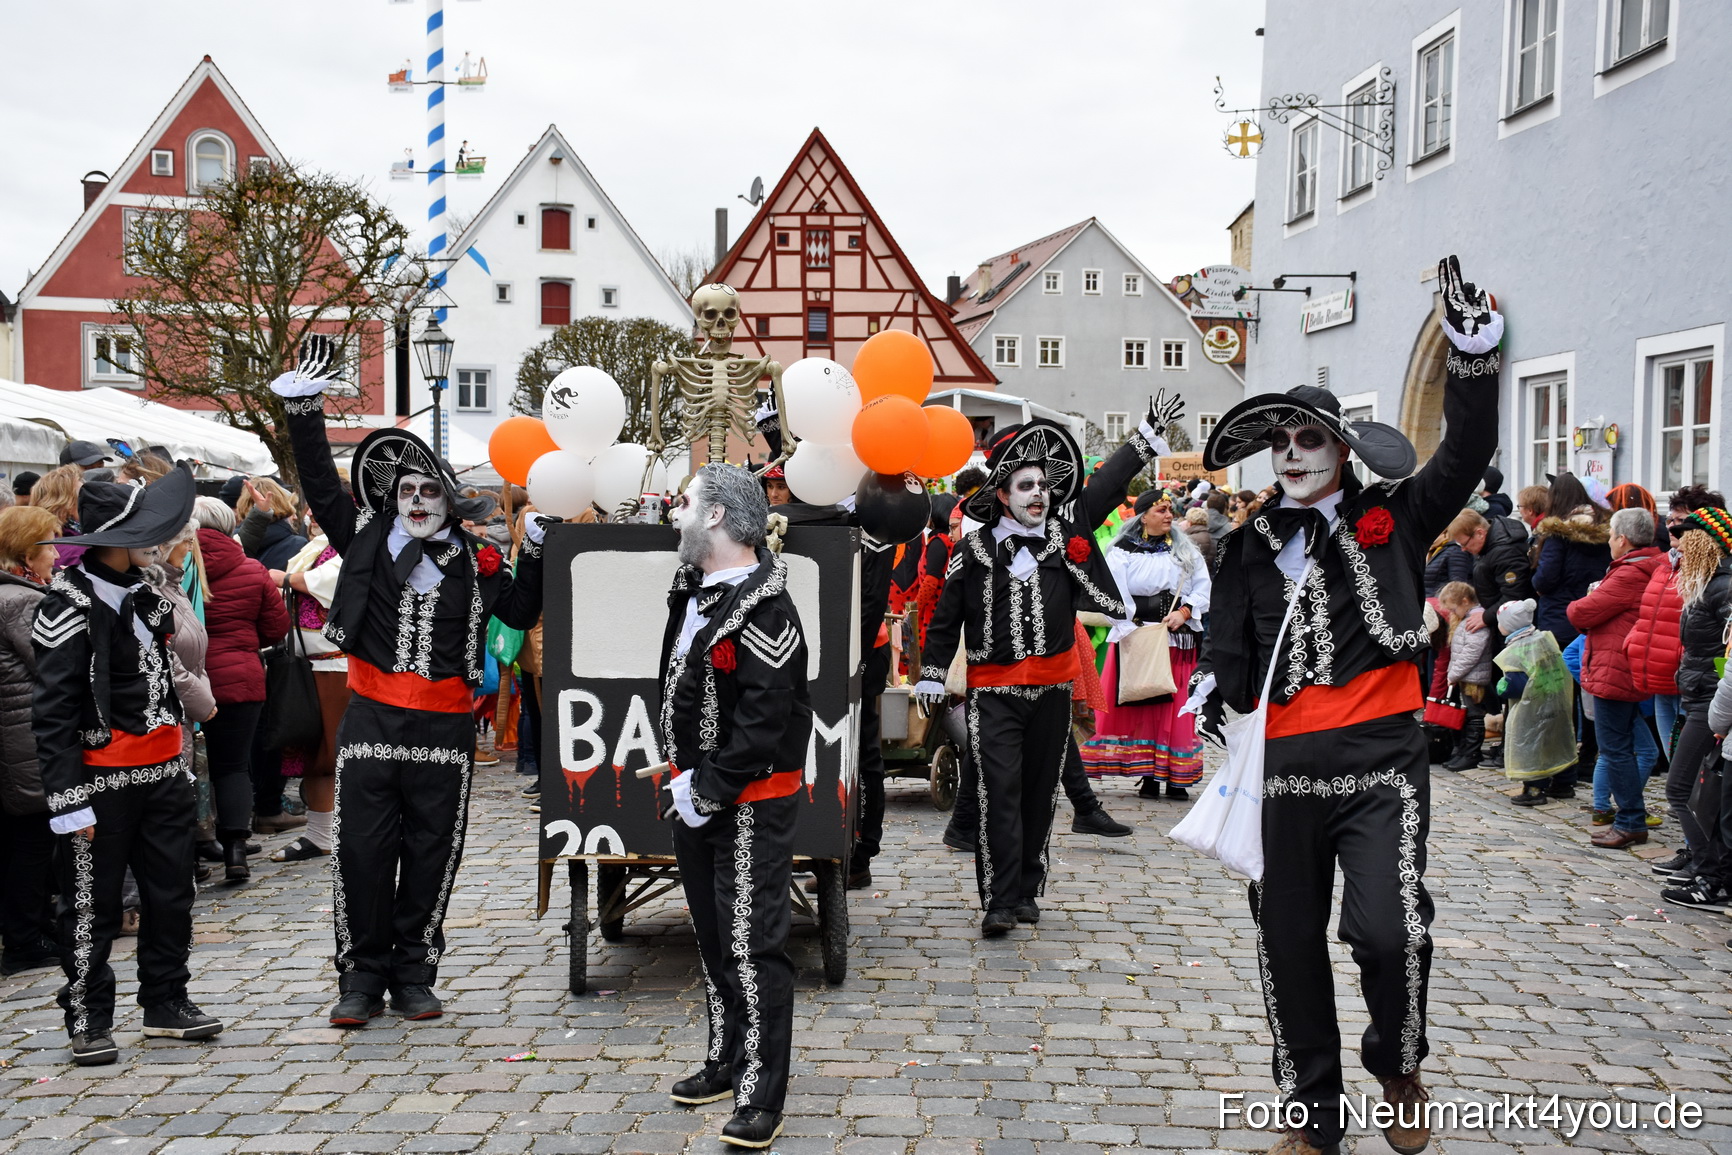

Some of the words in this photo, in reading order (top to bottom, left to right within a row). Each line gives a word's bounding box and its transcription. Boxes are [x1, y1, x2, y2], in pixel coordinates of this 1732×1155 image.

[1206, 267, 1239, 276] Pizzeria
[1213, 278, 1231, 286] Café
[1205, 288, 1235, 297] Eisdiel
[1308, 311, 1324, 328] Bella
[1324, 308, 1343, 323] Roma
[1172, 461, 1208, 474] Oenin
[1591, 460, 1603, 472] Eis
